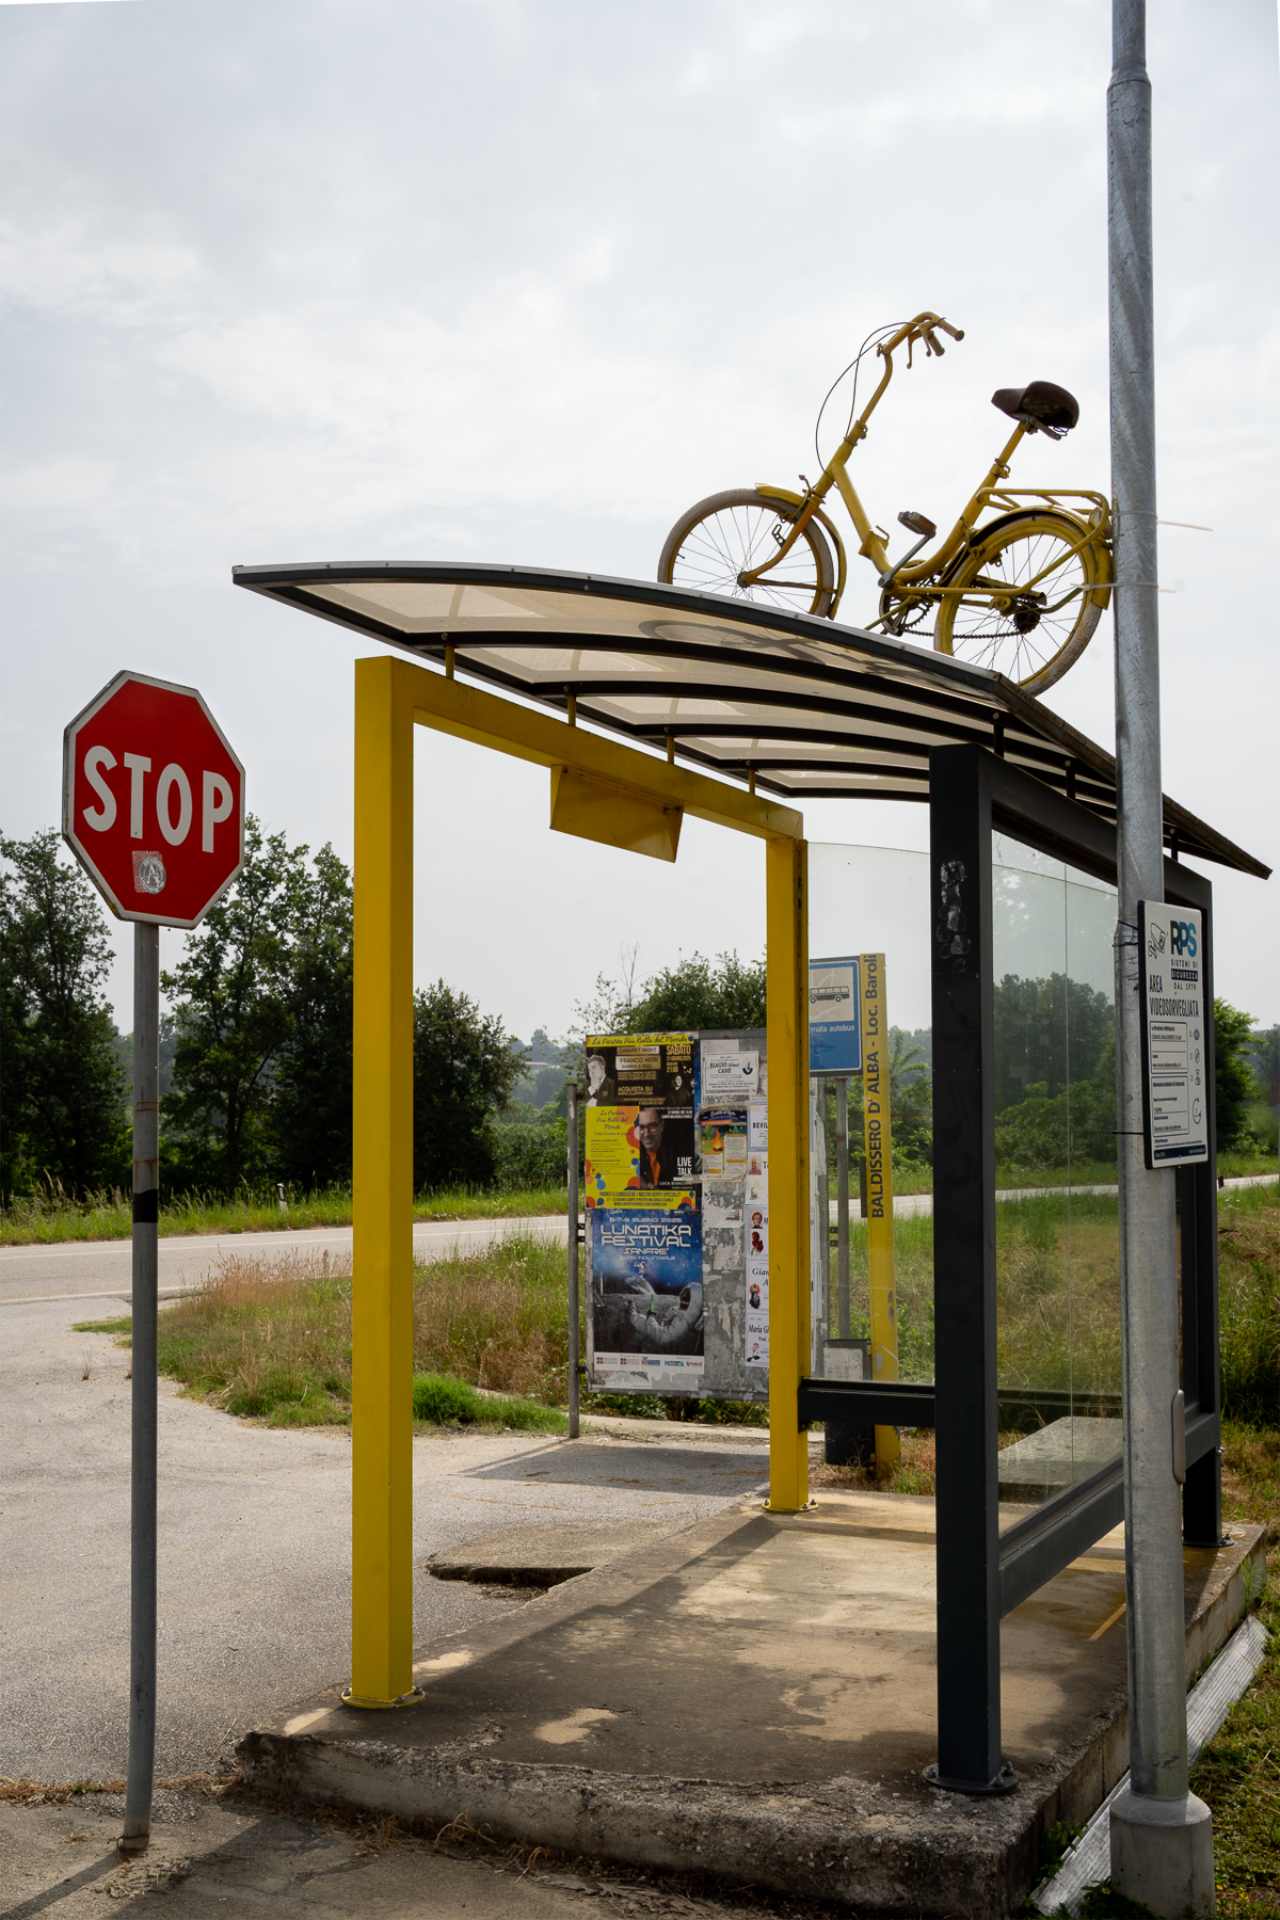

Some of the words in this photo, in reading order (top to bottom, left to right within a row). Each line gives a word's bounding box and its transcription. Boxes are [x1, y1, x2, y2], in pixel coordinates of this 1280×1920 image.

[82, 745, 234, 854] STOP
[1170, 919, 1197, 958] RPS
[864, 954, 878, 999] Baroli
[1149, 974, 1163, 992] AREA
[1149, 997, 1199, 1017] VIDEOSORVEGLIATA
[829, 1023, 855, 1032] autobus
[866, 1004, 879, 1036] Loc.
[666, 1045, 691, 1055] SABATO
[677, 1156, 692, 1167] LIVE
[868, 1119, 884, 1217] BALDISSERO
[677, 1167, 692, 1176] TALK
[600, 1224, 692, 1236] LUNATIKA
[601, 1235, 692, 1247] FESTIVAL
